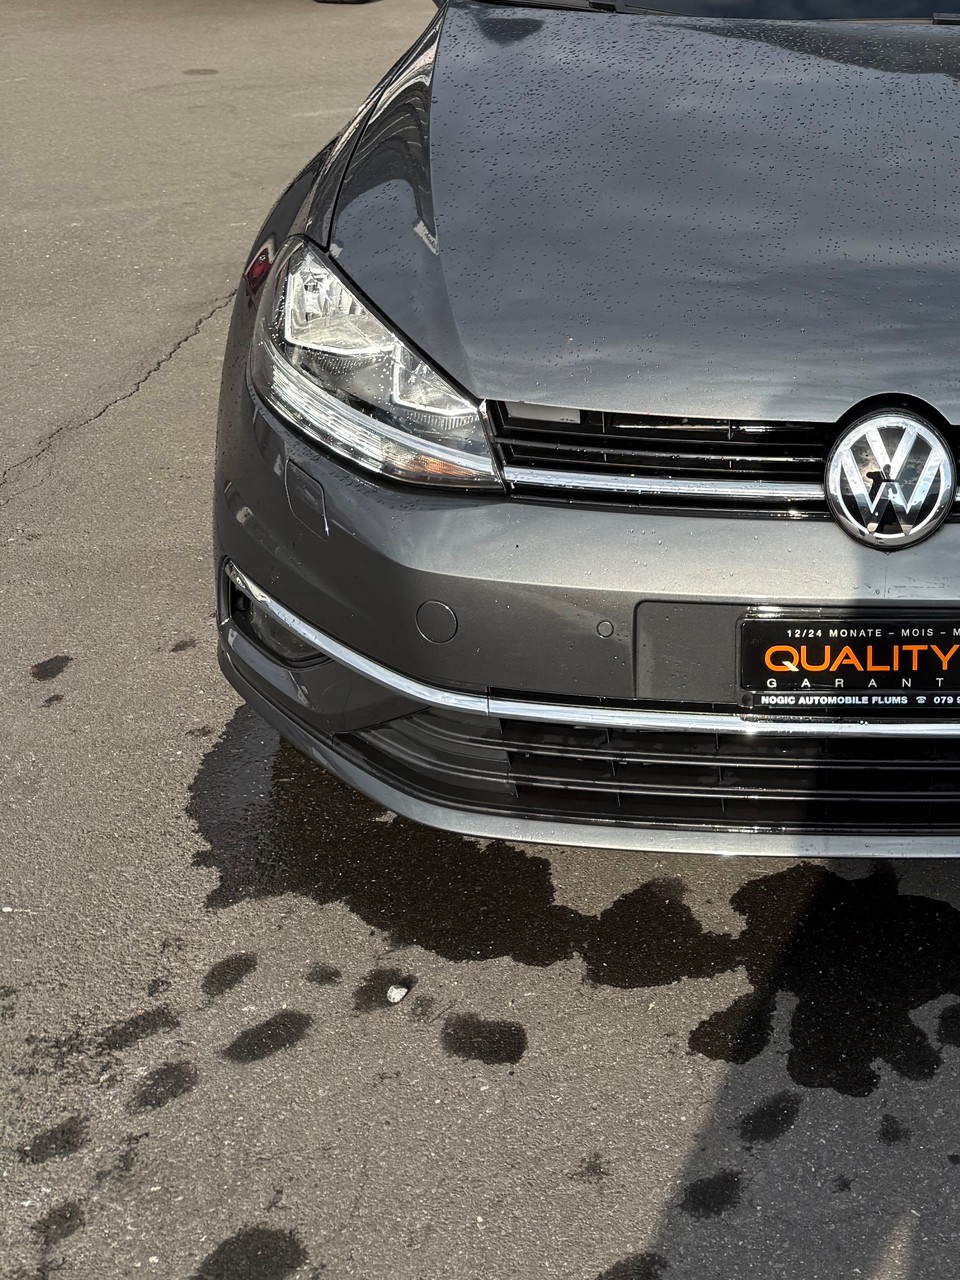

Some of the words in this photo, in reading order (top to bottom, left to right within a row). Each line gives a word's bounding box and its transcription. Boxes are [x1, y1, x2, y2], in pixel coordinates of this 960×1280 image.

[786, 629, 822, 638] 12/24
[829, 629, 882, 638] MONATE
[901, 628, 934, 637] MOIS
[764, 644, 960, 672] QUALITY
[761, 696, 796, 705] NOGIC
[798, 696, 869, 705] AUTOMOBILE
[871, 696, 908, 705] FLUMS
[933, 696, 954, 705] 079
